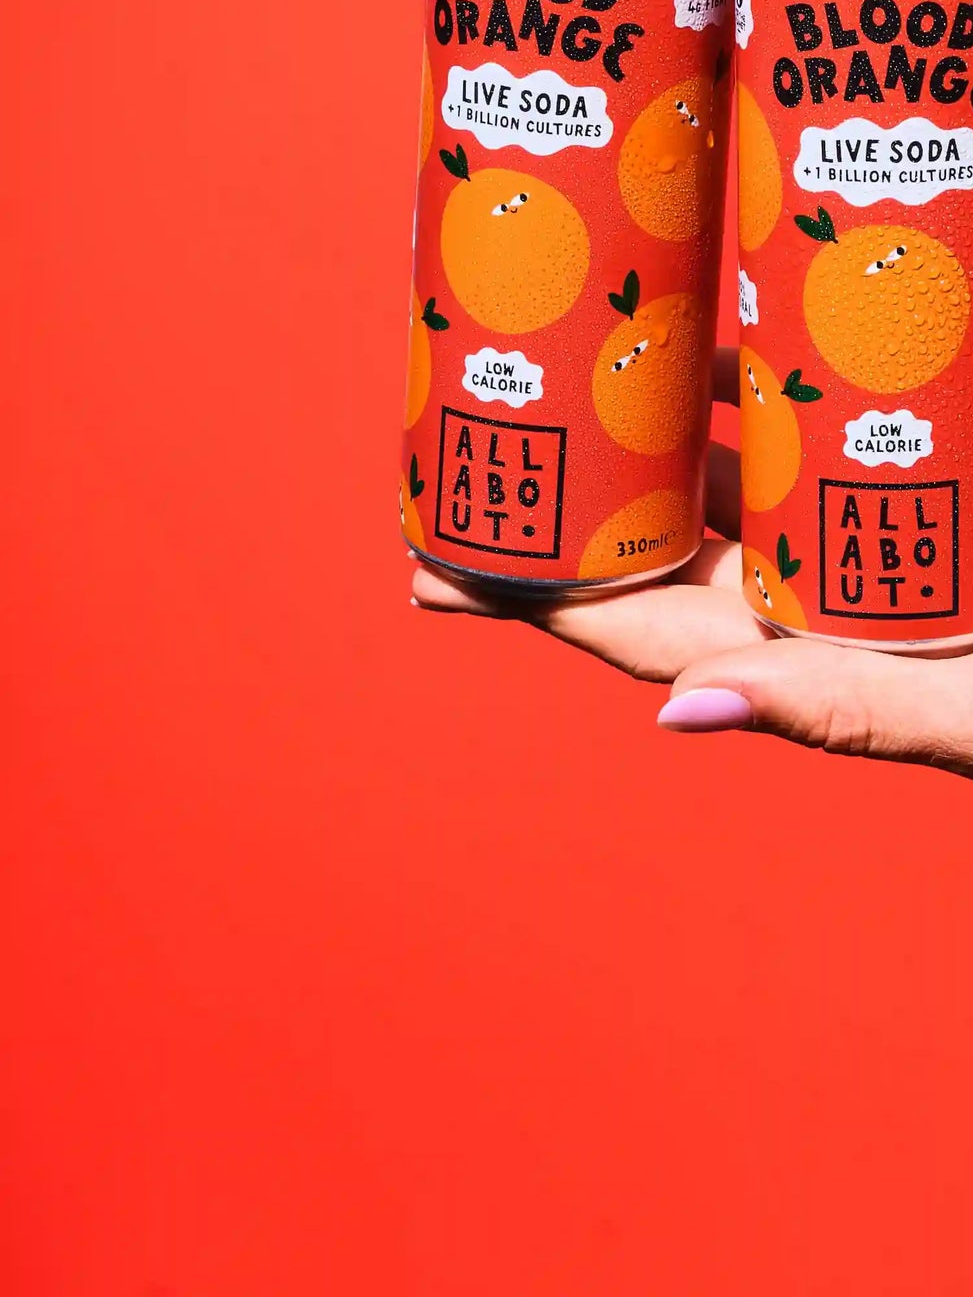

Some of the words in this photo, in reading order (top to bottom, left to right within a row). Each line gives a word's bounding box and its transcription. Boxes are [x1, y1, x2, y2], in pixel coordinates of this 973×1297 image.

[462, 79, 511, 109] LIVE
[519, 89, 588, 119] SODA
[466, 108, 520, 131] BILLION
[526, 120, 602, 137] CULTURES
[821, 139, 880, 164] LIVE
[890, 138, 960, 163] SODA
[828, 168, 892, 183] BILLION
[899, 165, 973, 184] CULTURES
[486, 361, 515, 377] LOW
[472, 373, 533, 395] CALORIE
[870, 424, 902, 438] LOW
[456, 426, 543, 471] ALL
[855, 439, 922, 452] CALORIE
[453, 465, 540, 508] ABO
[840, 494, 938, 531] ALL
[840, 534, 937, 571] ABO
